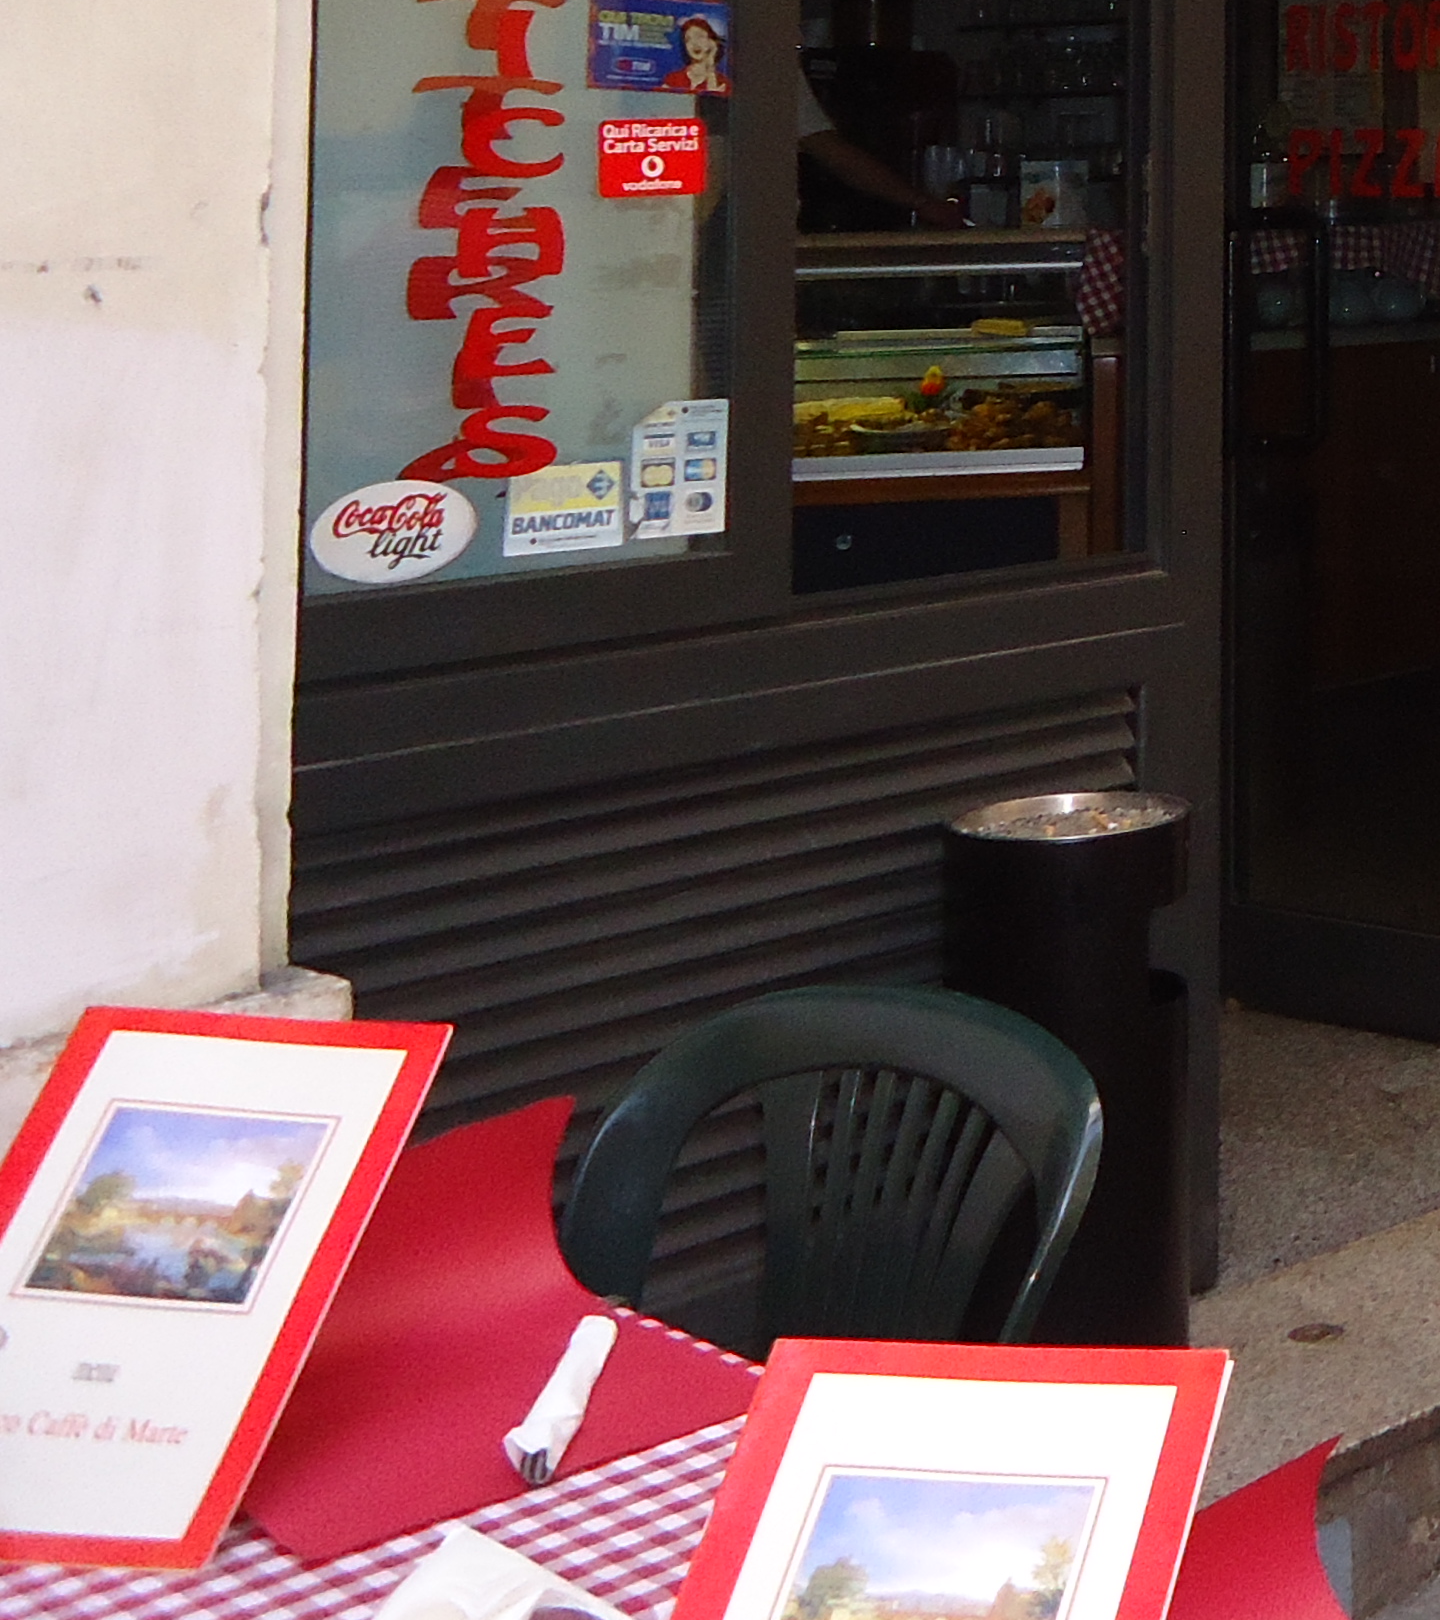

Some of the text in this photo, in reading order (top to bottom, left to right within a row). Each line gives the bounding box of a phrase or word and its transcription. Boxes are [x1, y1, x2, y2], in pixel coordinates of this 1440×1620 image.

[598, 22, 640, 41] TIM
[602, 123, 699, 139] Qui Ricarica e
[603, 137, 699, 154] Carta Servizi
[511, 509, 617, 536] BANCOMAT
[366, 526, 444, 571] light
[127, 1417, 189, 1445] Marte
